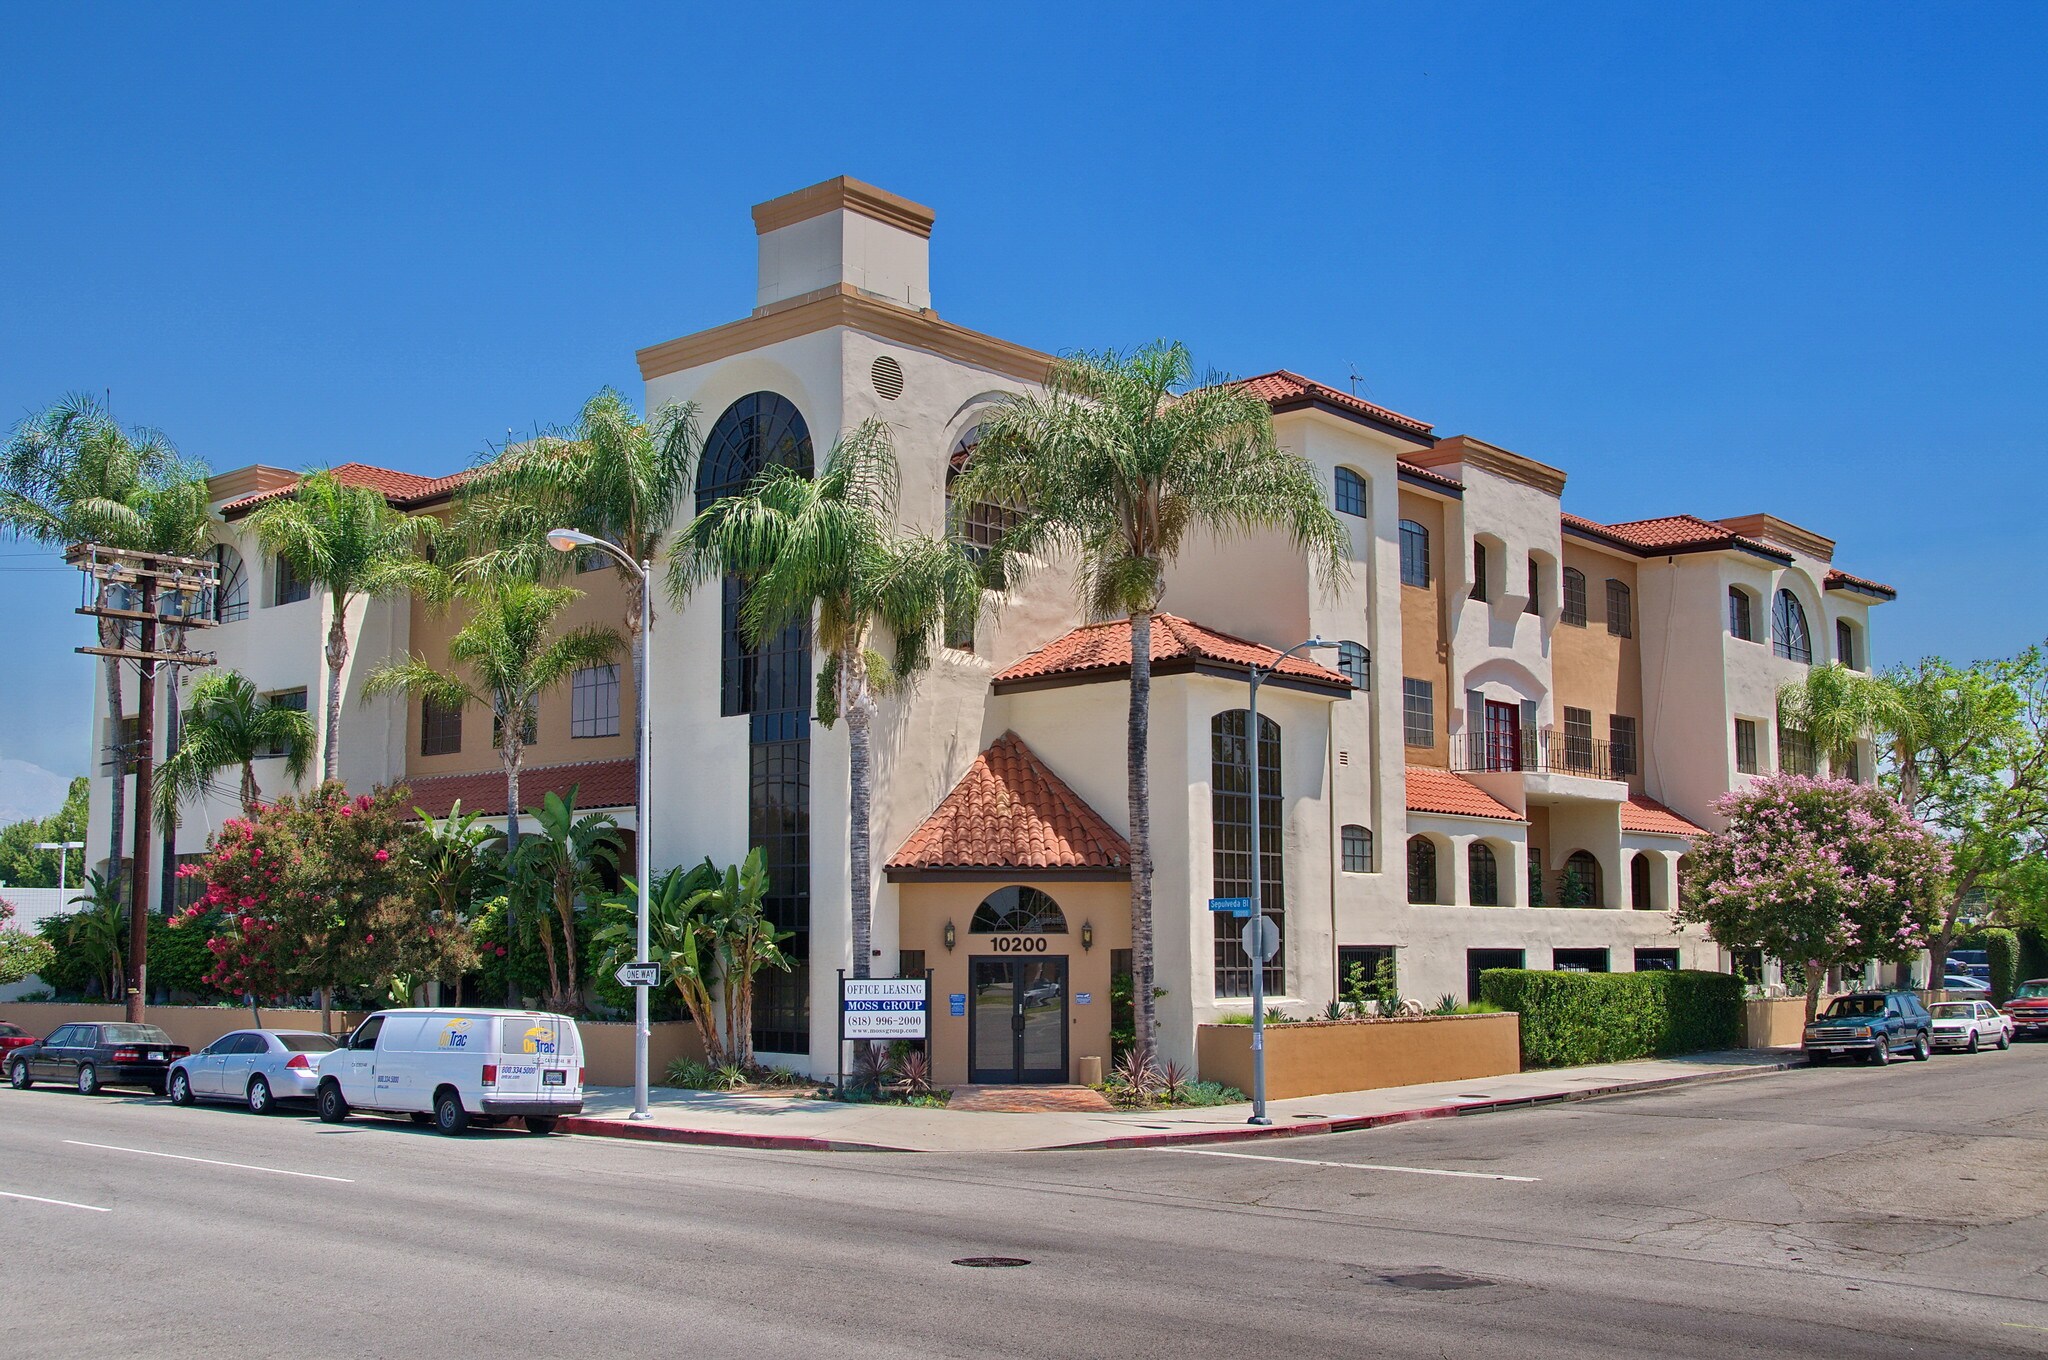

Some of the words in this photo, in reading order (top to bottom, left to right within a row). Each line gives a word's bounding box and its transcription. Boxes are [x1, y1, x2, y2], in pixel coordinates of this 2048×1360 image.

[1210, 899, 1241, 909] Sepulveda
[990, 936, 1047, 952] 10200
[627, 971, 639, 979] ONE
[642, 970, 654, 978] WAY
[847, 984, 880, 995] OFFICE
[883, 984, 922, 995] LEASING
[847, 1001, 879, 1011] MOSS
[882, 1000, 923, 1010] GROUP
[848, 1015, 872, 1026] (818)
[875, 1016, 922, 1026] 996-2000
[438, 1030, 468, 1047] OnTrac
[523, 1038, 555, 1054] OnTrac
[501, 1066, 536, 1075] 800.334.5000
